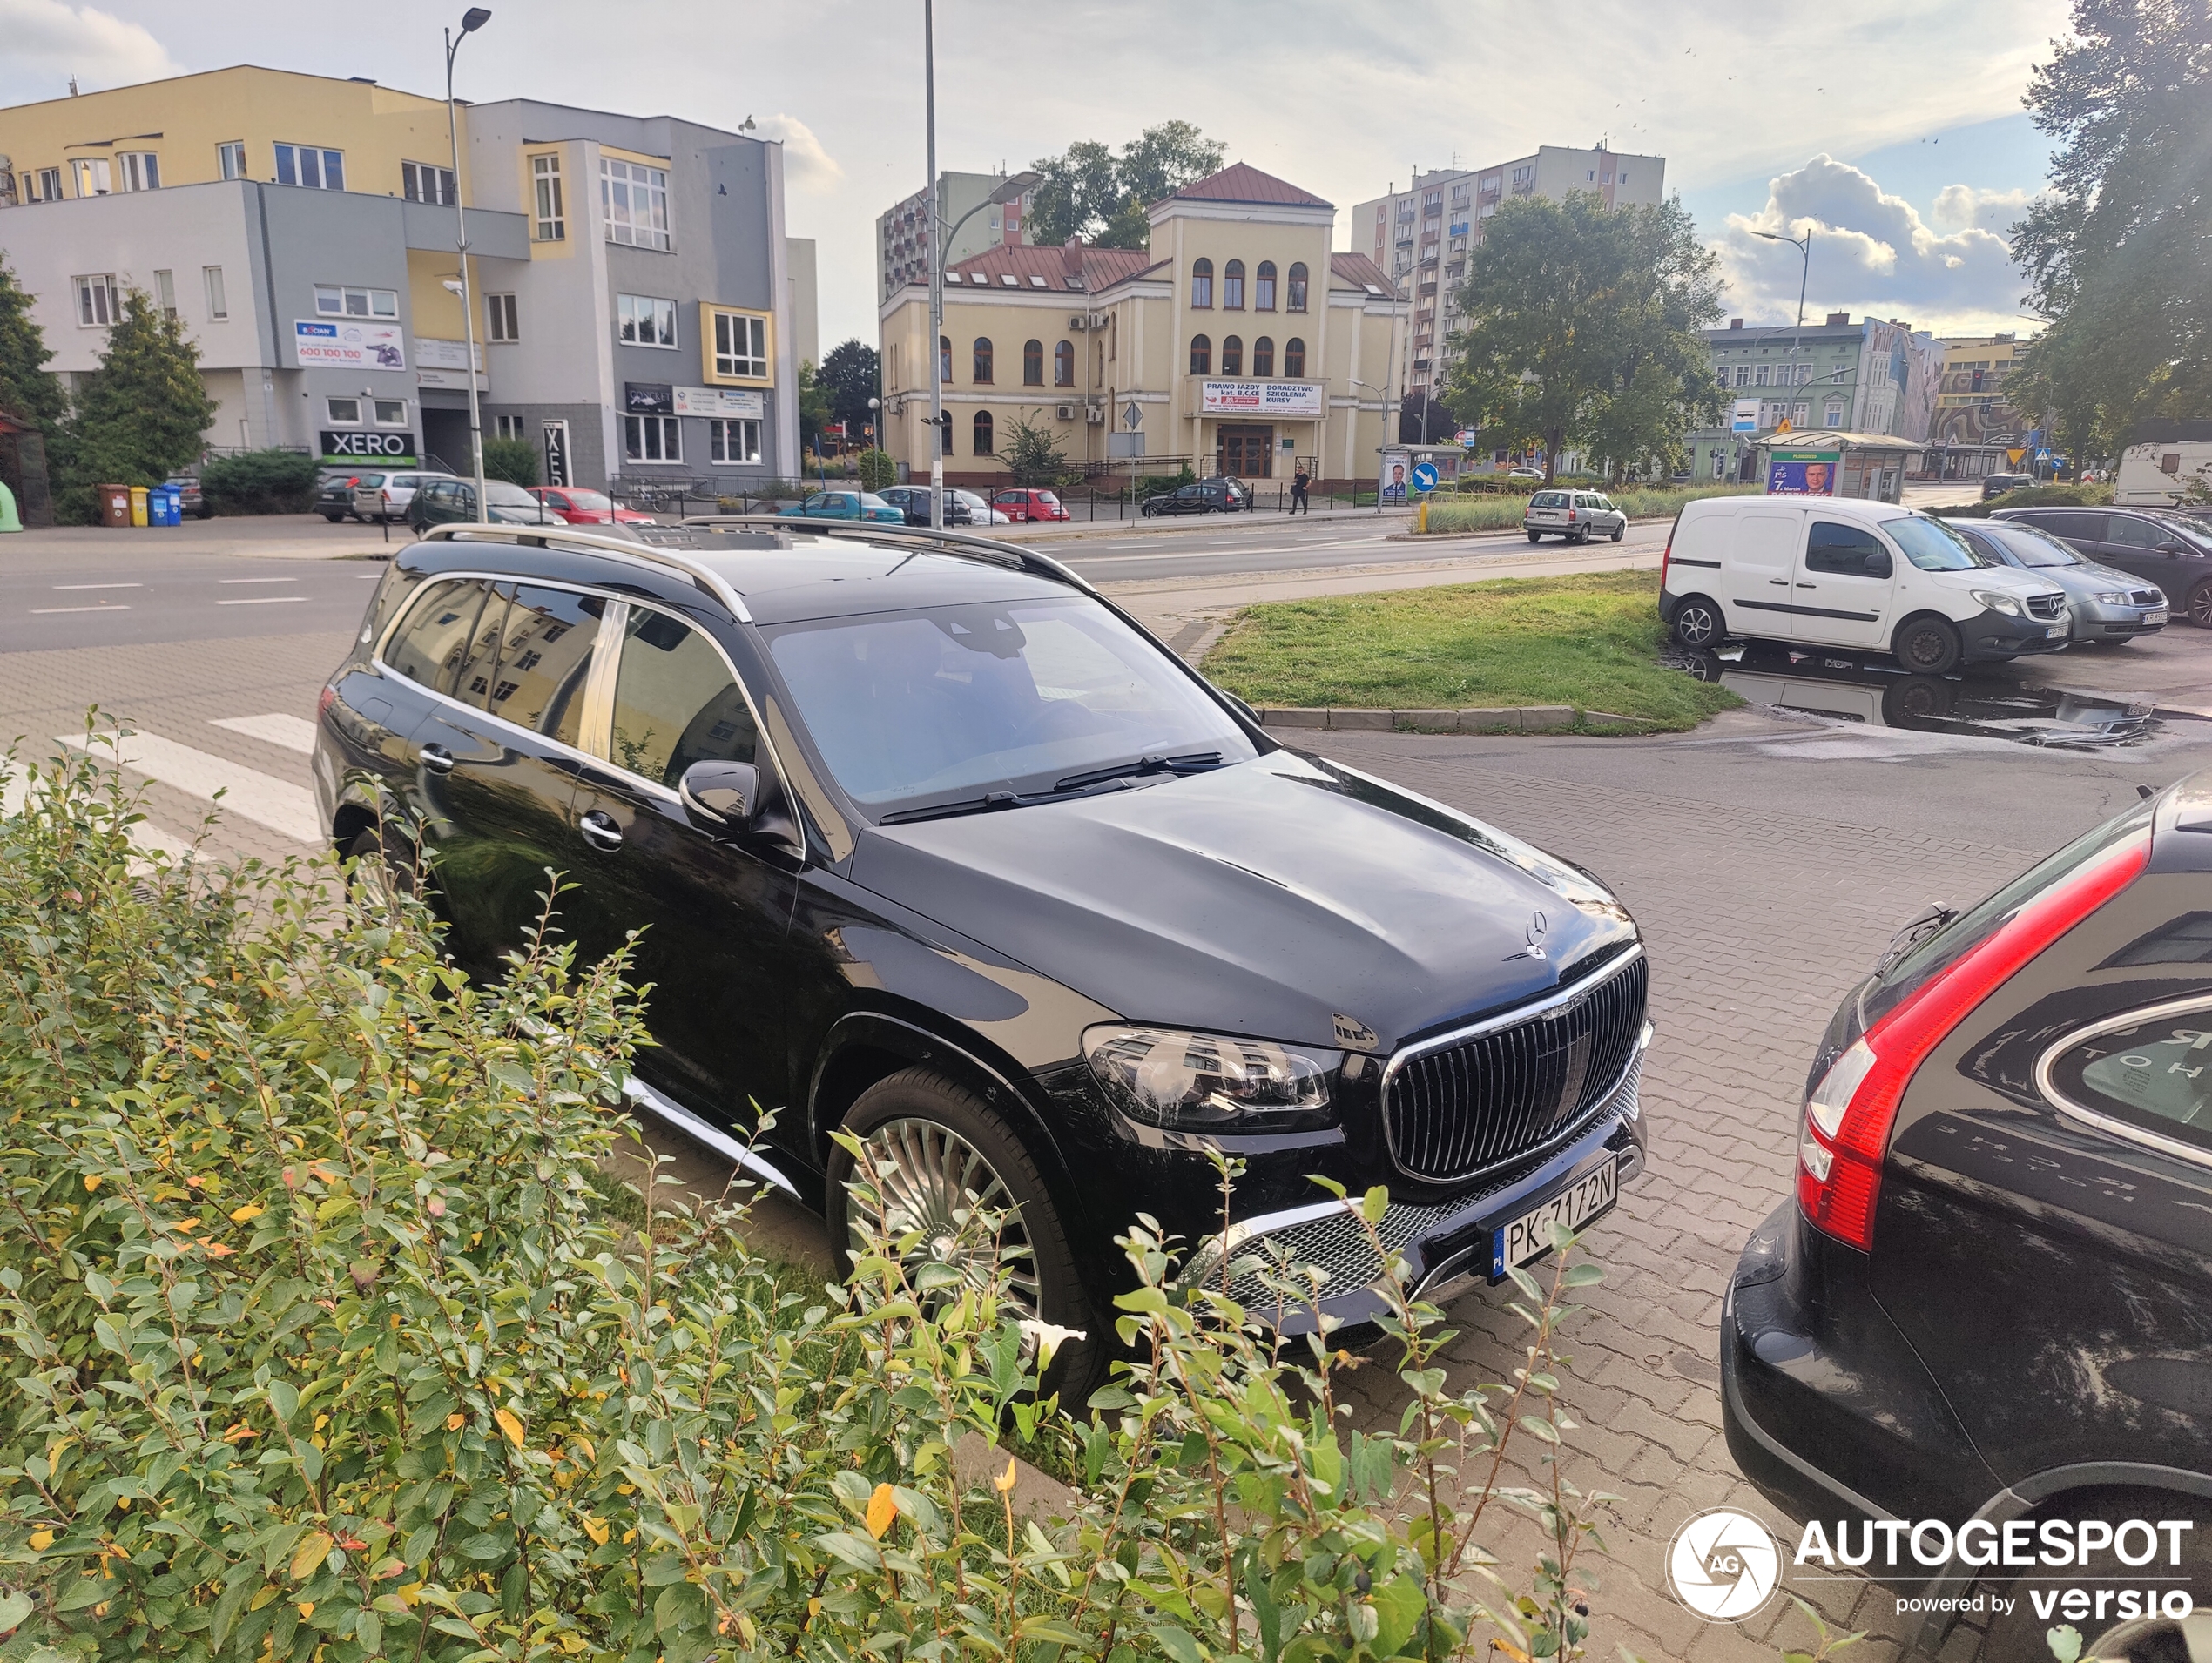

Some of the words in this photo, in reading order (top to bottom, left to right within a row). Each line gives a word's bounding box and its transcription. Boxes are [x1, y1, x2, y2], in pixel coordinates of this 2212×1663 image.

[302, 326, 330, 334] BOCIAN
[300, 347, 320, 356] 600
[323, 348, 341, 358] 100
[343, 349, 361, 359] 100
[333, 434, 405, 455] XERO
[1510, 1211, 1541, 1262] PK
[1550, 1163, 1612, 1226] 7172N
[1493, 1257, 1502, 1269] PL
